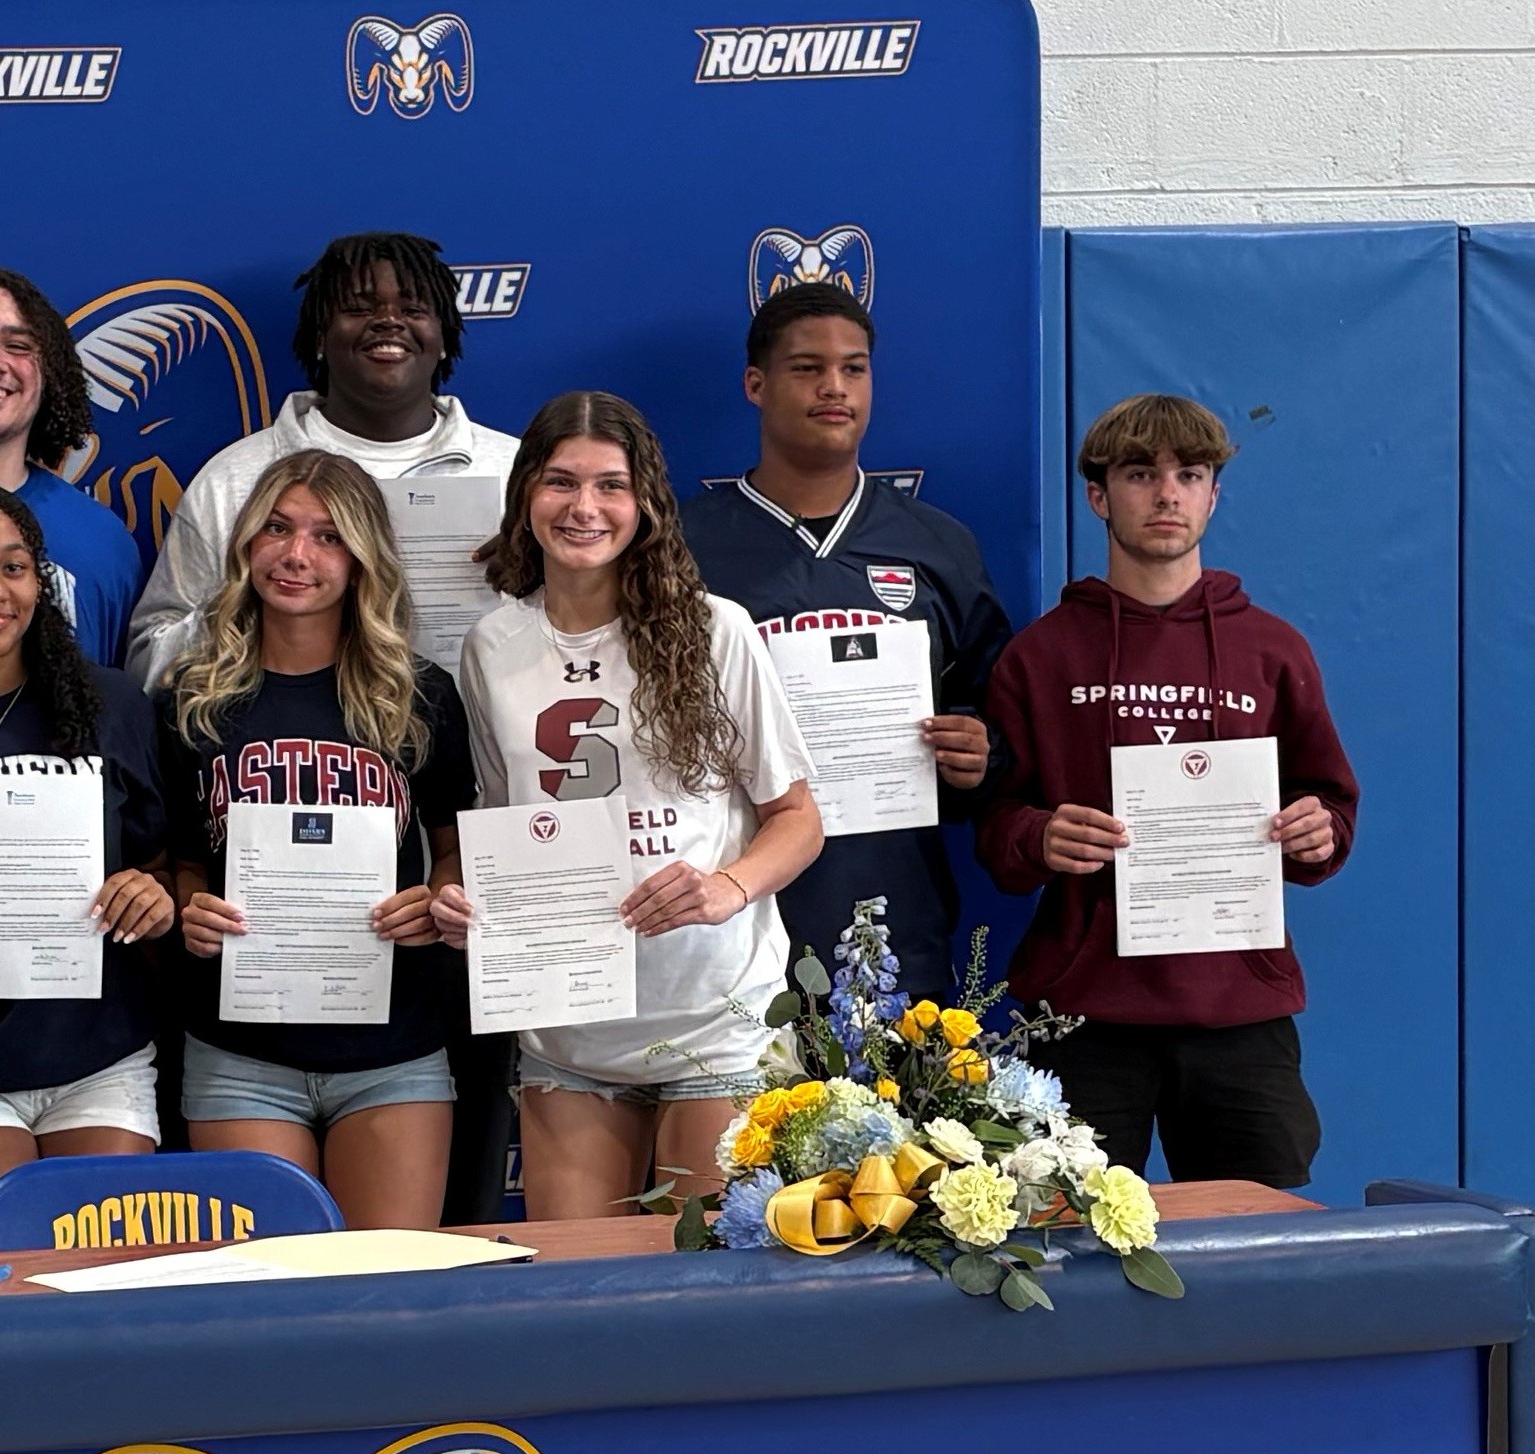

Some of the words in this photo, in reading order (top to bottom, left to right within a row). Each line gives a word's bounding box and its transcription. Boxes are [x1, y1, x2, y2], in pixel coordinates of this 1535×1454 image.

[704, 28, 912, 78] ROCKVILLE
[1117, 706, 1212, 720] COLLEGE
[197, 738, 411, 852] ASTERN
